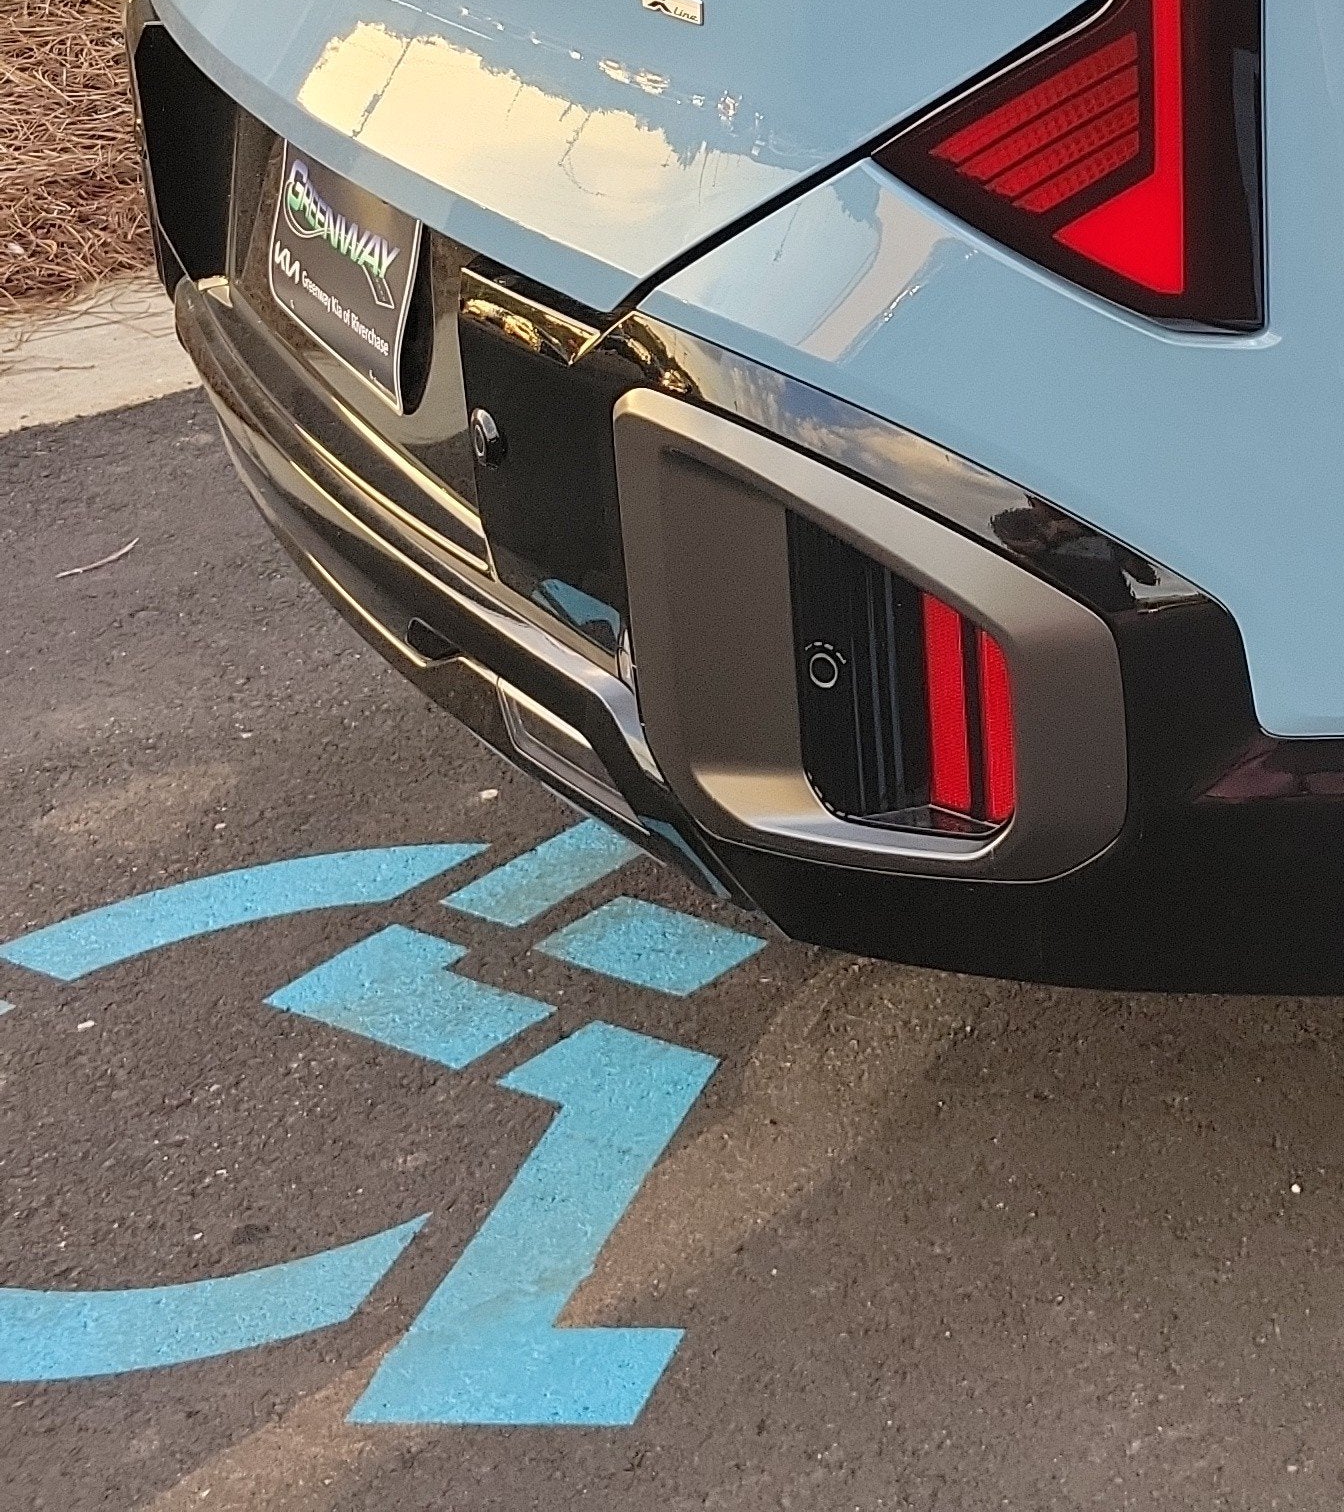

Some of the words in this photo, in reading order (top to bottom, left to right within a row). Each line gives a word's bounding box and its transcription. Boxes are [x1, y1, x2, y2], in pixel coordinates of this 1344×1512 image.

[286, 159, 401, 279] GREENWAY
[302, 271, 331, 313] Greenway
[331, 295, 343, 319] Kia
[351, 313, 389, 357] Riverchase
